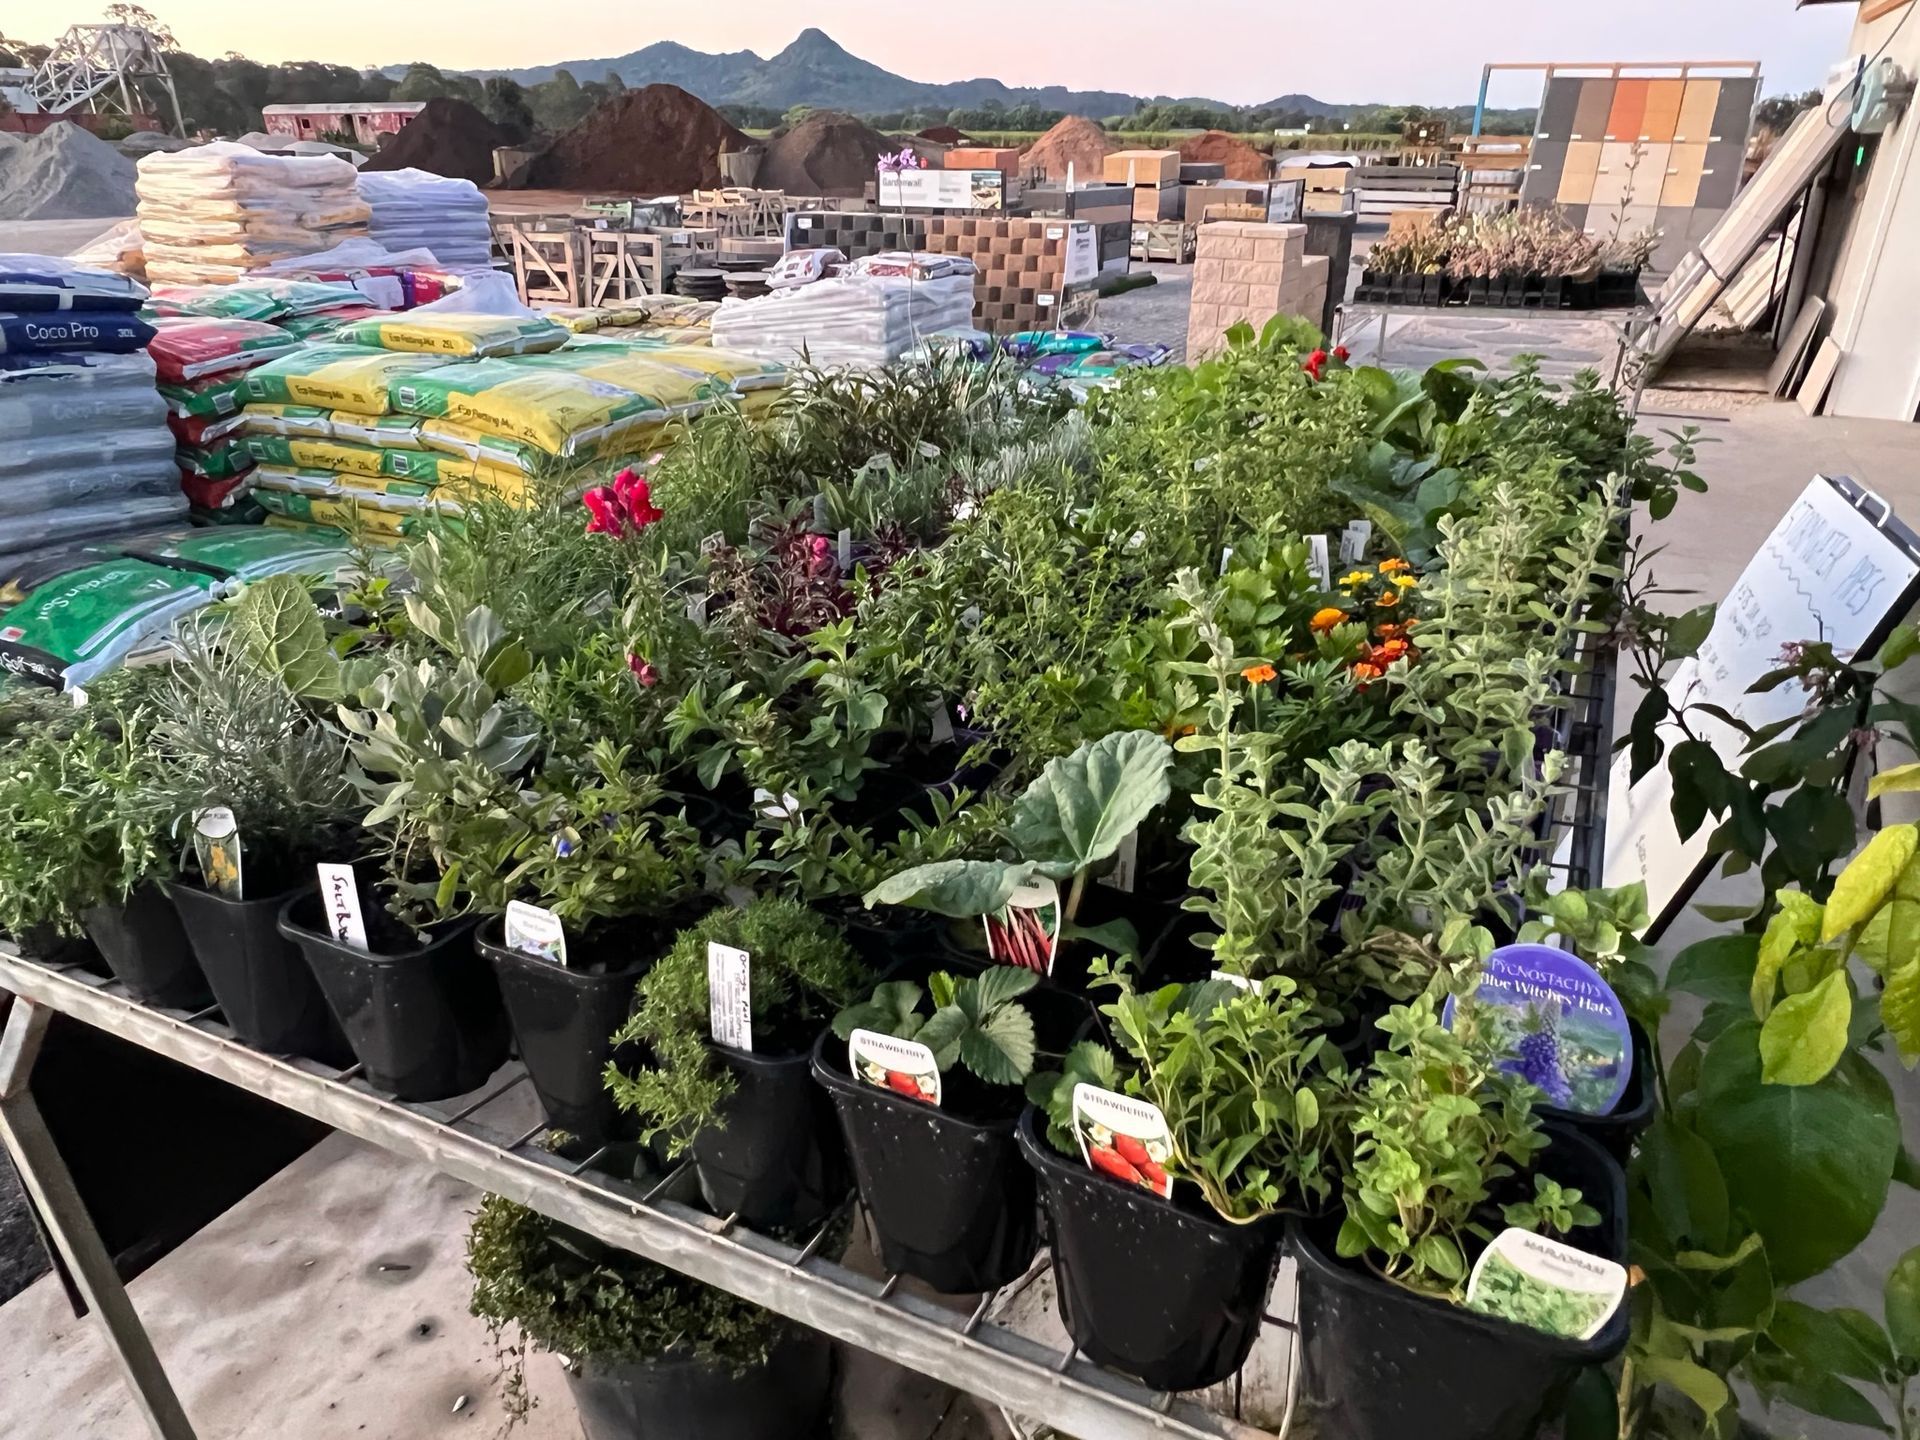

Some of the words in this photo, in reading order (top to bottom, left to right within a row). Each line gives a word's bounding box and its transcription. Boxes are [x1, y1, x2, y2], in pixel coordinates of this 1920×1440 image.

[26, 323, 68, 340] Coco
[70, 322, 99, 338] Pro
[117, 328, 136, 338] 30L
[442, 339, 455, 349] 25L
[1491, 958, 1601, 997] PYCNOSTACHYS
[1480, 971, 1512, 990] Blue
[1578, 996, 1613, 1016] Hats
[860, 1037, 925, 1059] STRAWBERRY
[1083, 1092, 1154, 1120] STRAWBERRY
